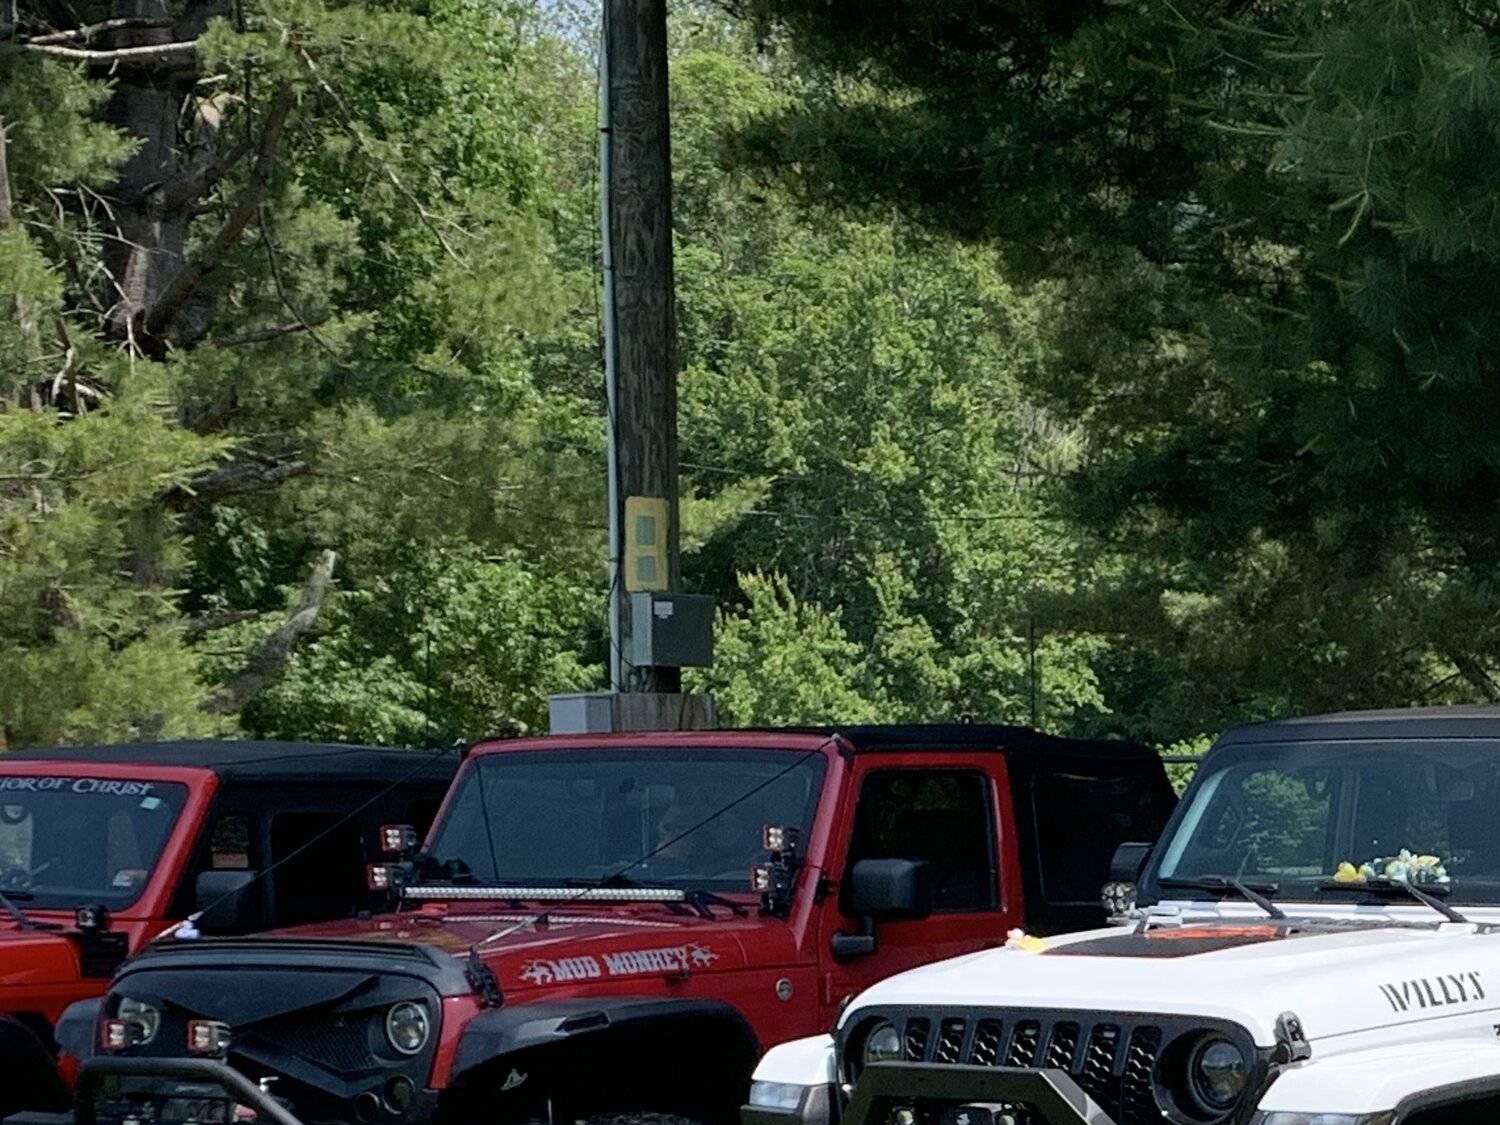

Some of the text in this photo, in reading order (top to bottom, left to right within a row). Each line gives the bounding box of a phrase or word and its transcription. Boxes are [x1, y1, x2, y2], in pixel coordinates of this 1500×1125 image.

[37, 777, 71, 790] OF
[72, 778, 155, 796] CHRIST
[548, 945, 690, 982] MUD MONKEY
[1378, 971, 1486, 1012] WILLYS
